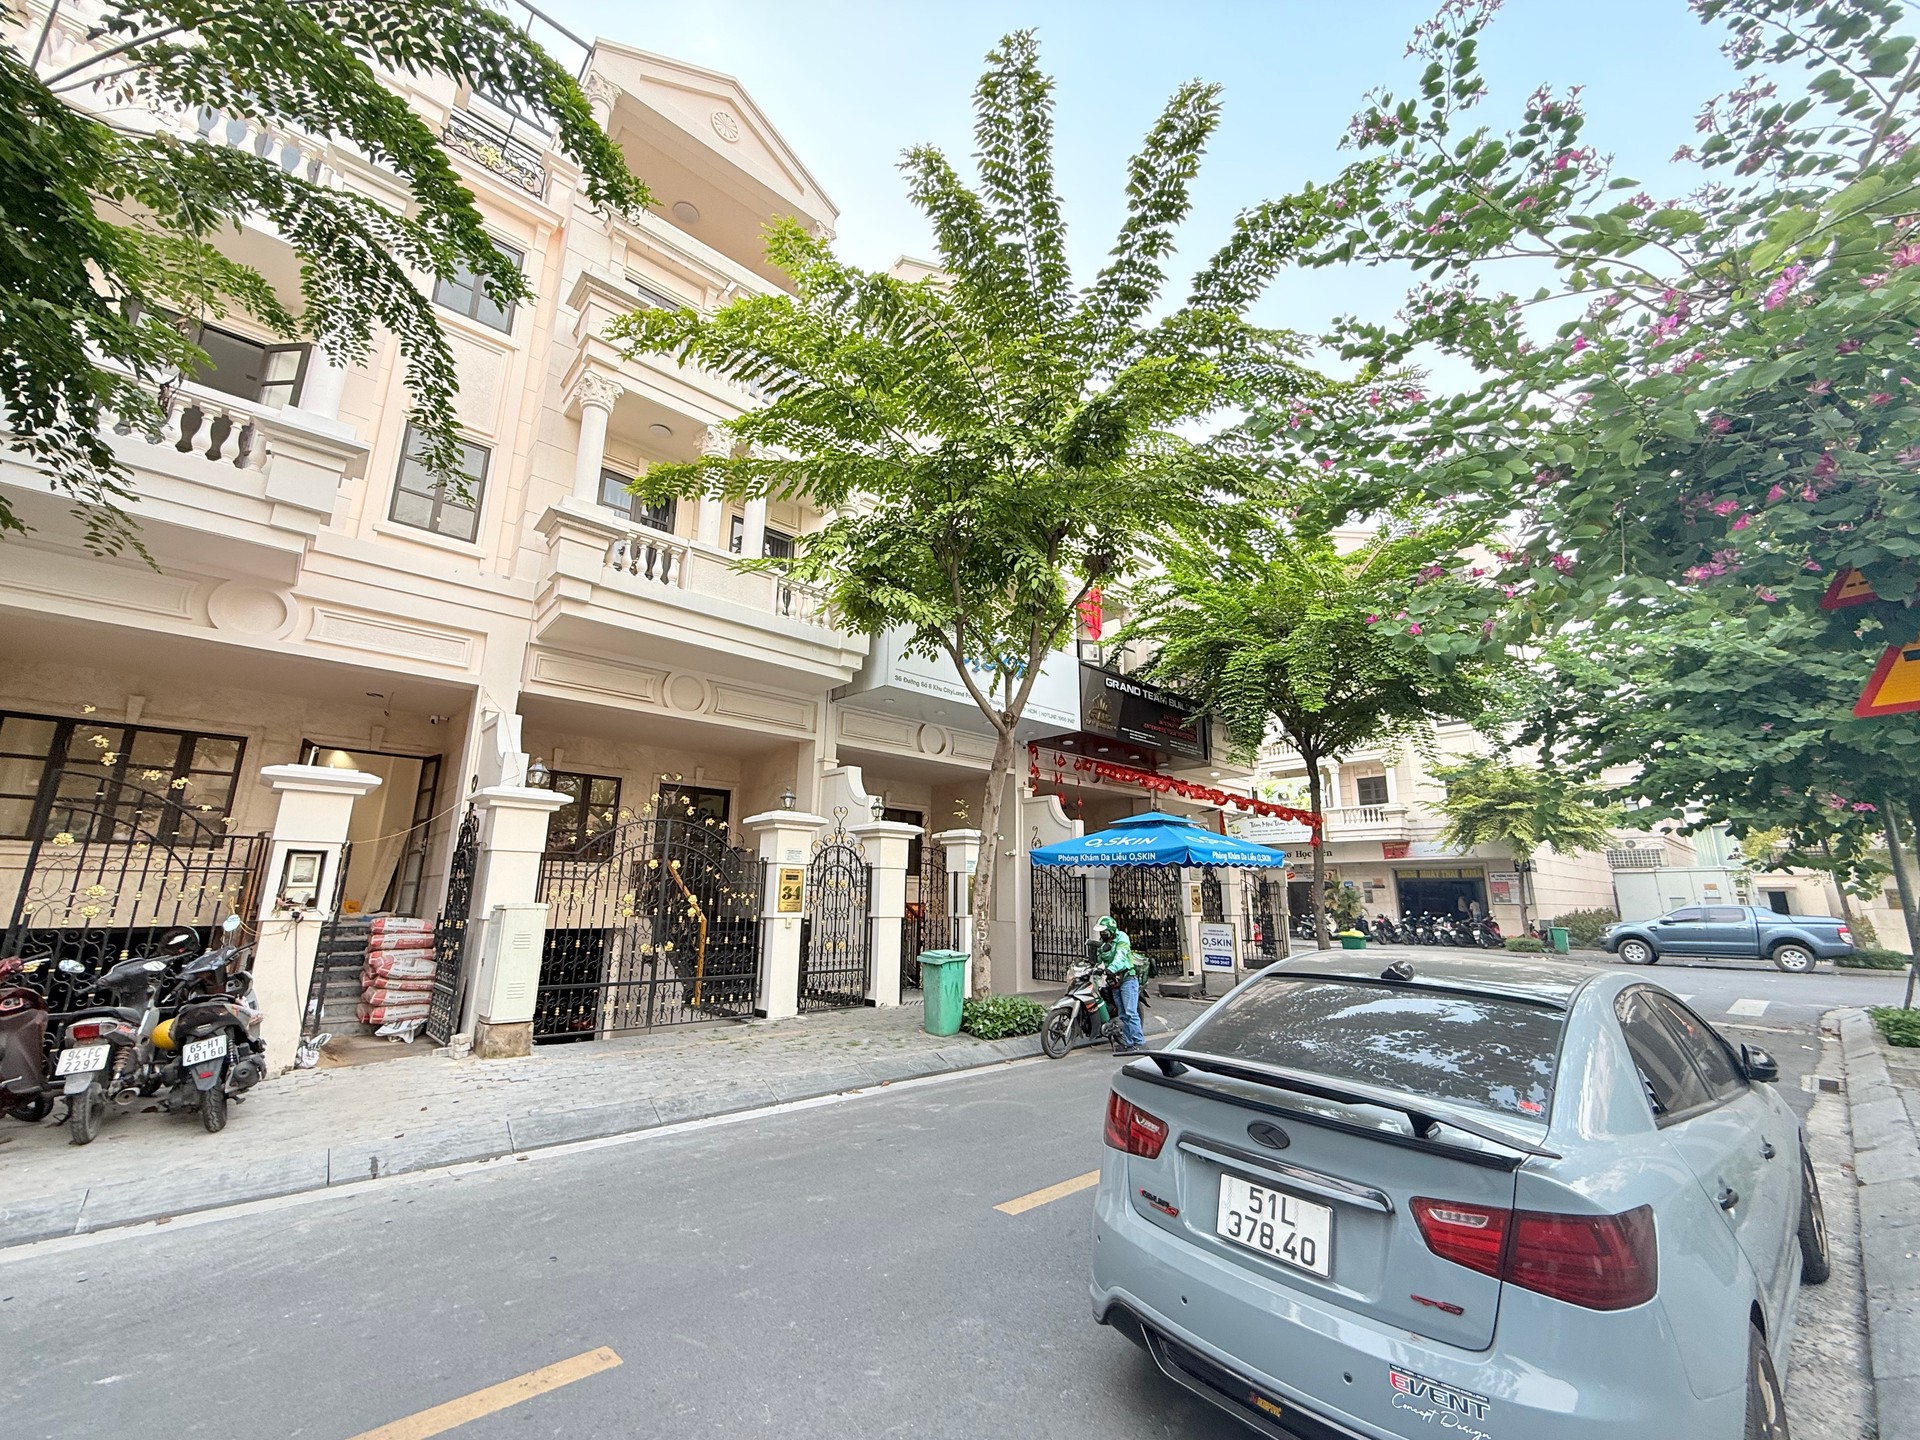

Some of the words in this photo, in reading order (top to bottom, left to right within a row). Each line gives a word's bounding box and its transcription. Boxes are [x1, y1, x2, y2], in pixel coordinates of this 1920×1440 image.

[1105, 677, 1141, 697] GRAND
[1142, 689, 1167, 706] TEAM
[1058, 854, 1079, 863] Phòng
[1080, 853, 1099, 861] Khám
[1101, 853, 1110, 861] Da
[1112, 852, 1126, 861] Liễu
[1212, 851, 1227, 861] Phòng
[1296, 850, 1312, 859] Học
[782, 886, 801, 901] 34
[190, 1038, 219, 1054] 65-H1
[64, 1058, 100, 1072] 2297
[1249, 1186, 1296, 1227] 51L
[1228, 1210, 1316, 1266] 378.40
[1390, 1370, 1490, 1420] EVENT
[1392, 1392, 1440, 1423] Concept
[1440, 1410, 1491, 1440] Design
